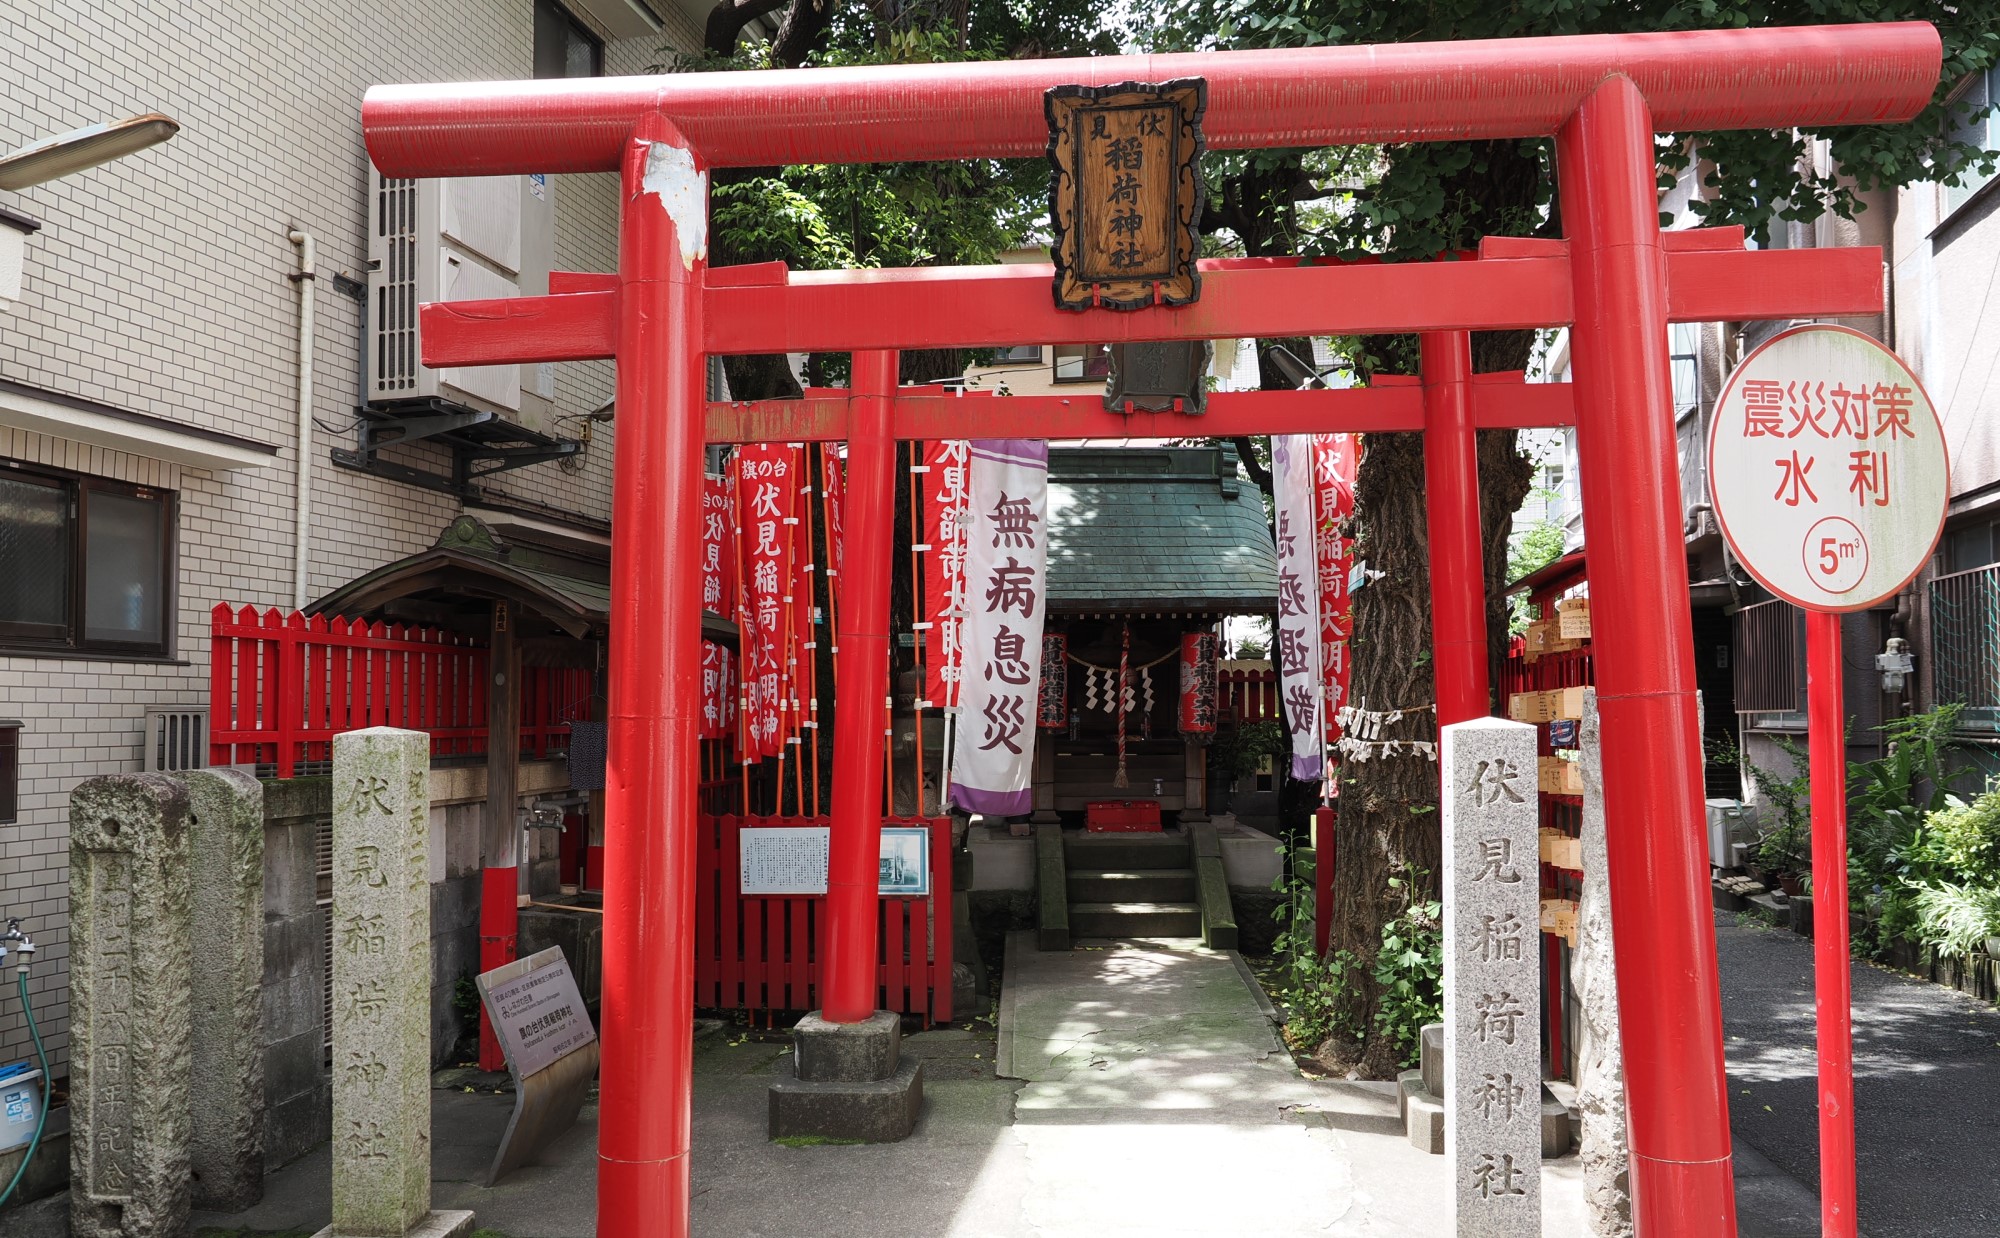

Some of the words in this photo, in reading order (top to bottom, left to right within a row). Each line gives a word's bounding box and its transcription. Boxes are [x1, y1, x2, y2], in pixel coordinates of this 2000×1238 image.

[742, 458, 787, 479] 旗の台
[1742, 380, 1915, 440] 震災対策
[1775, 450, 1818, 507] 水
[1848, 450, 1889, 507] 利
[751, 482, 782, 745] 伏見稲荷大明神
[978, 490, 1039, 755] 無病息災
[342, 775, 394, 1161] 伏見稲荷神社
[1466, 758, 1526, 1200] 伏見稲荷神社
